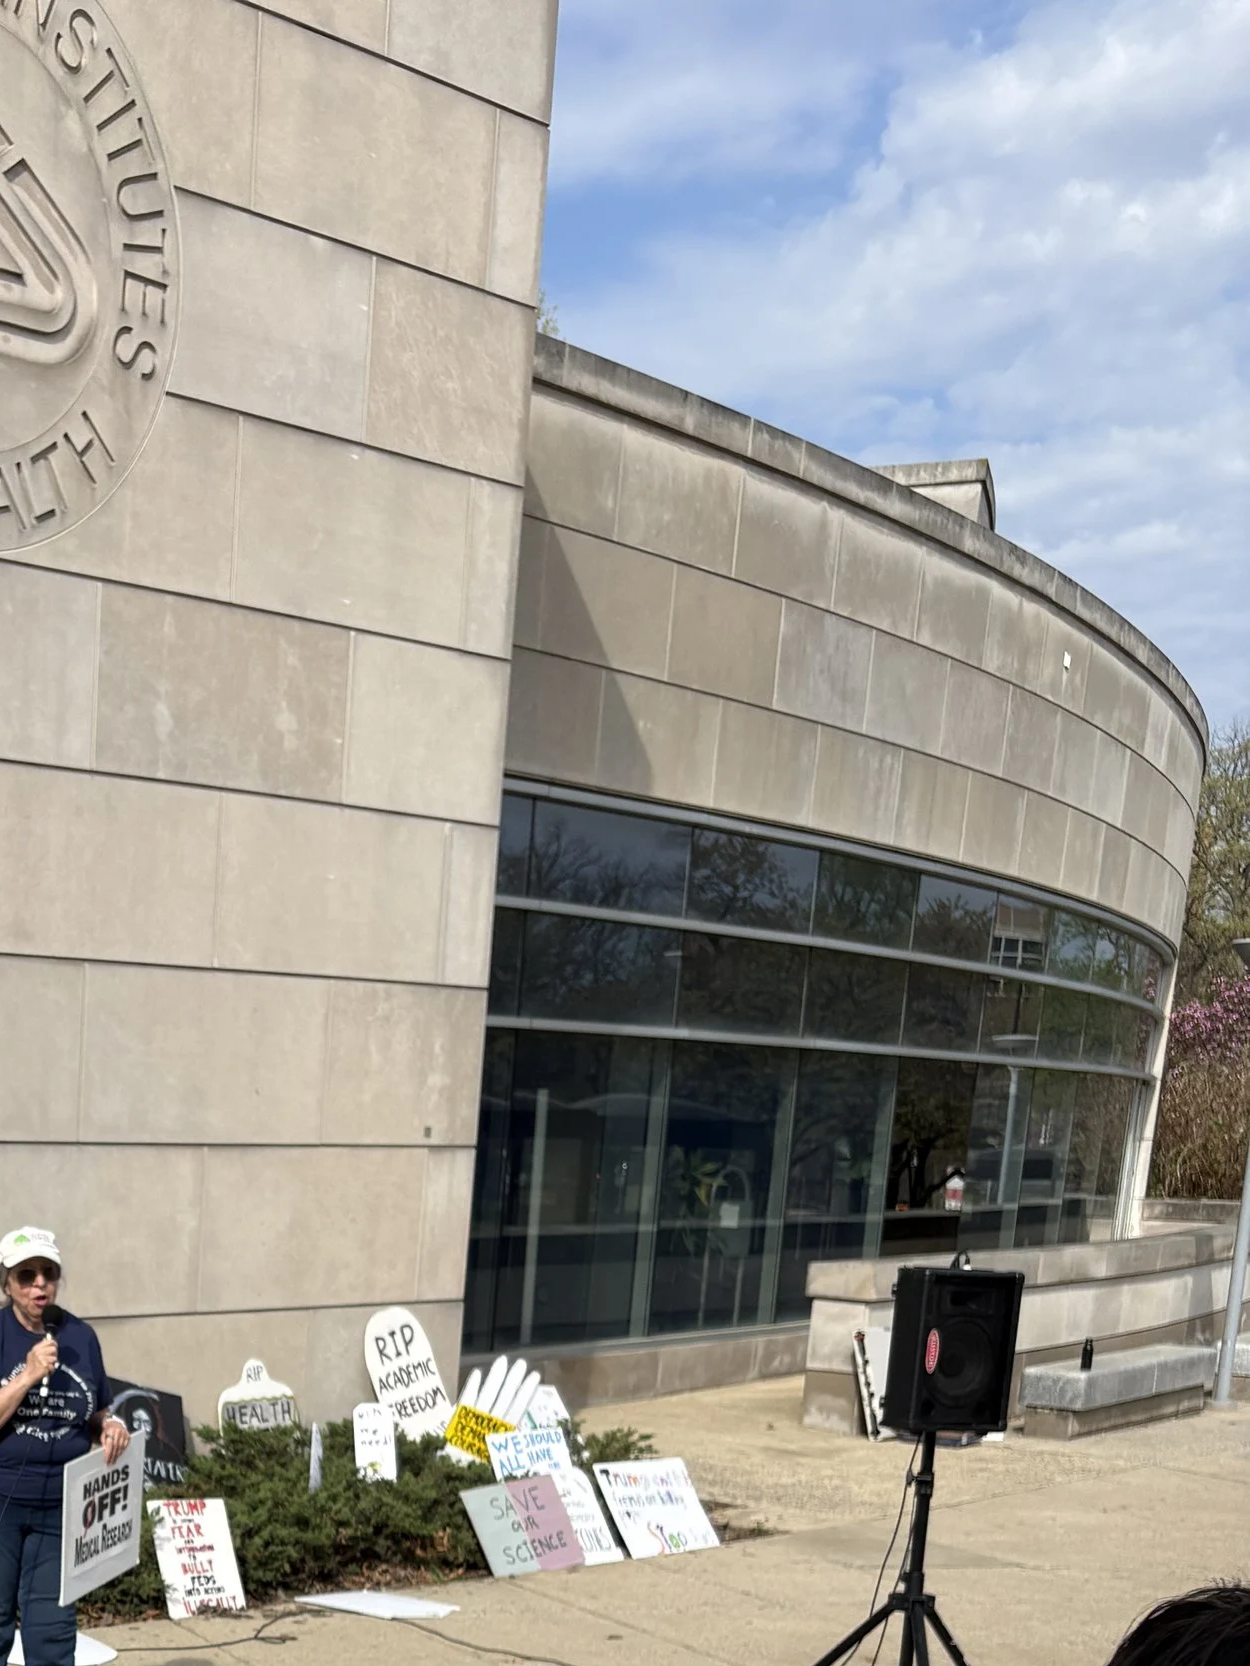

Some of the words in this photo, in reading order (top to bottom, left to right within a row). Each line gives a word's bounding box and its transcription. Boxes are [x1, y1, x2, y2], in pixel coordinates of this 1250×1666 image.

[374, 1323, 415, 1365] RIP
[246, 1365, 264, 1383] RIP
[378, 1357, 436, 1395] ACADEMIC
[17, 1407, 40, 1417] One
[42, 1407, 78, 1421] Family
[50, 1398, 64, 1408] are
[226, 1399, 291, 1425] HEALTH
[491, 1433, 524, 1455] WE
[524, 1430, 562, 1451] SHOULD
[500, 1454, 526, 1478] ALL
[526, 1450, 554, 1467] HAVE
[83, 1464, 130, 1501] HANDS
[82, 1484, 129, 1531] OFF!
[162, 1499, 207, 1517] TRUMP
[490, 1485, 546, 1521] SAVE
[171, 1523, 204, 1539] FEAR
[502, 1530, 568, 1566] SCIENCE
[181, 1559, 214, 1576] BULLY
[191, 1575, 217, 1587] FEDS
